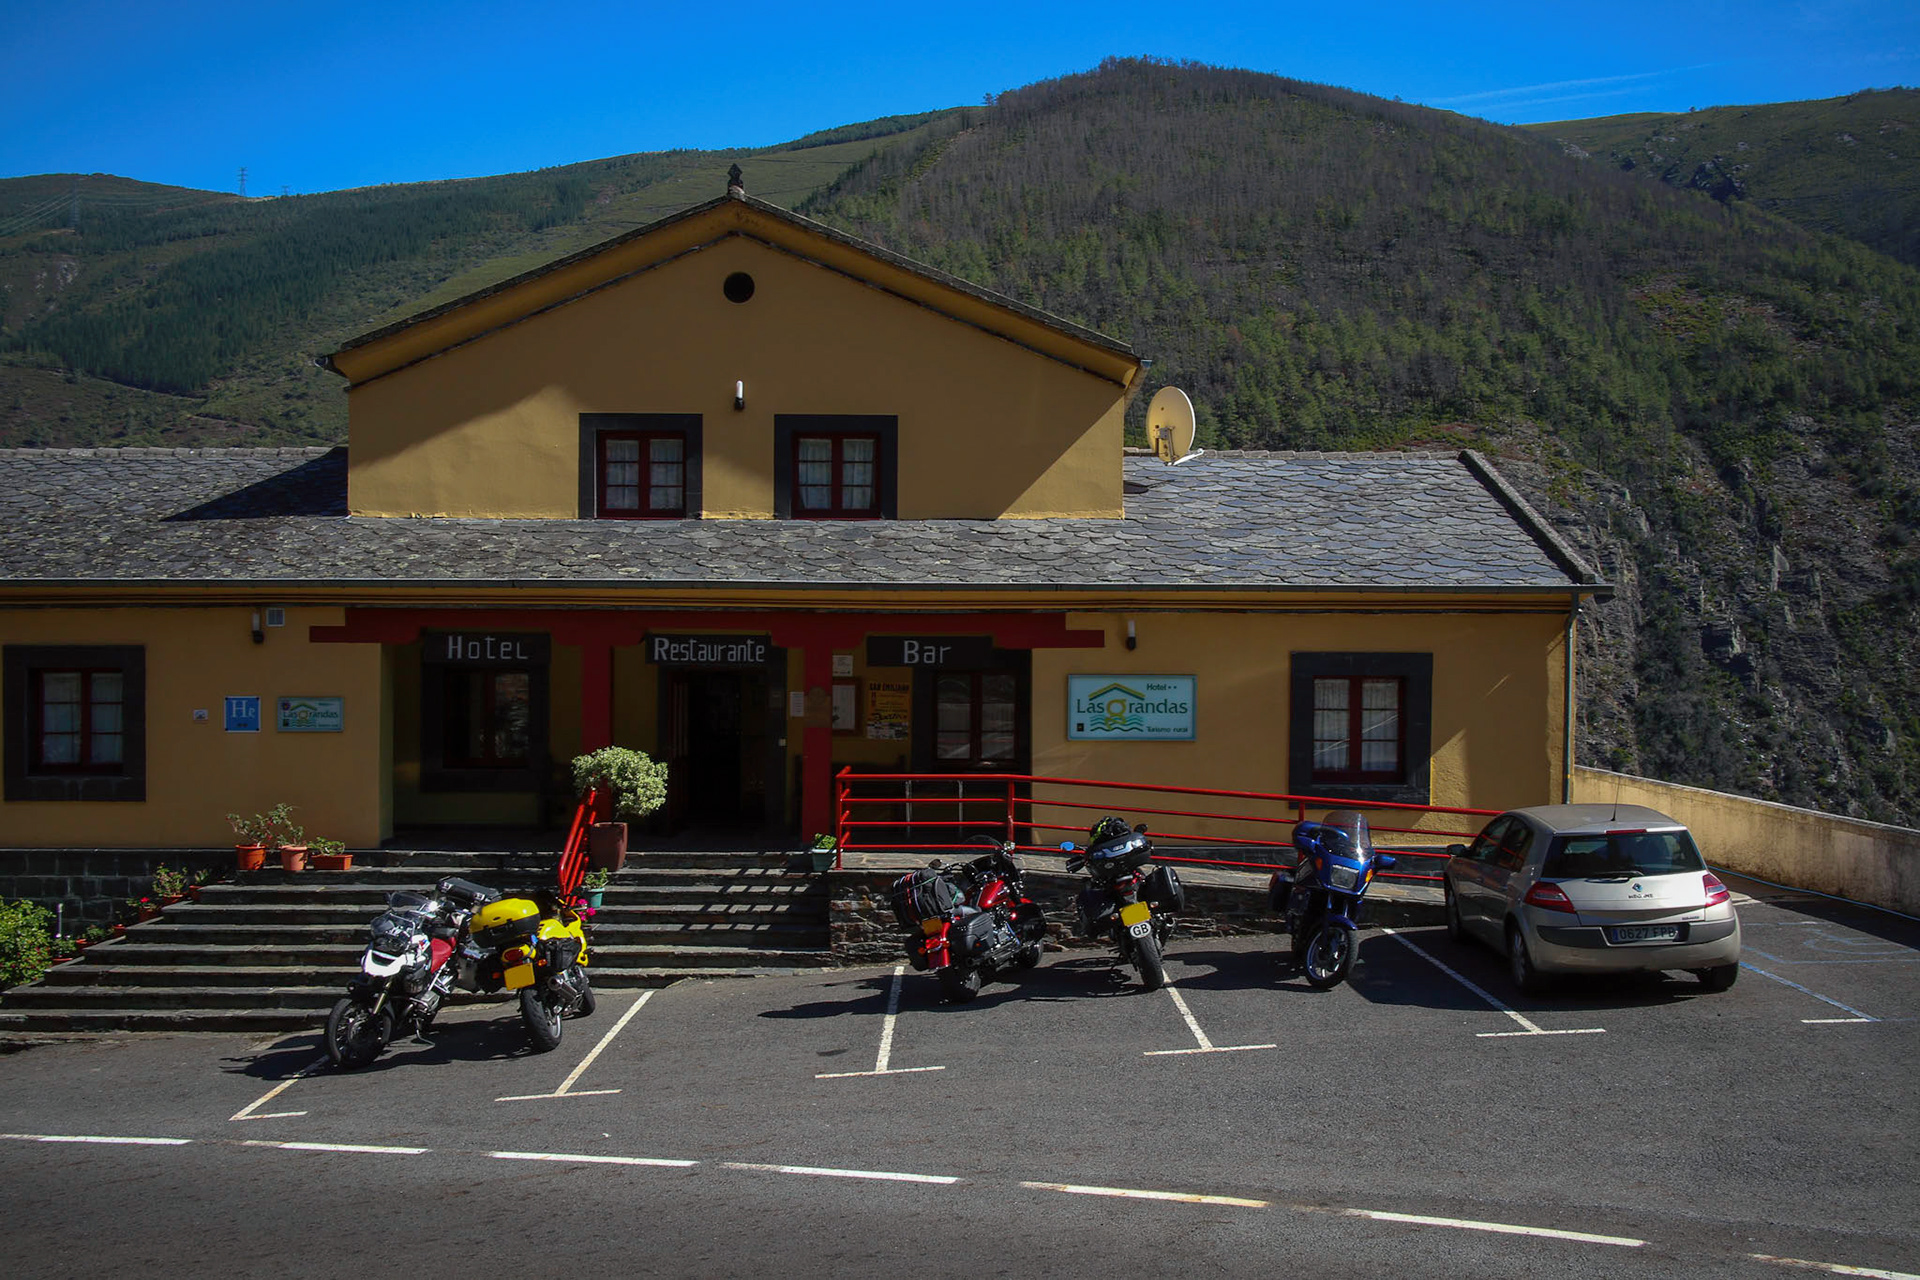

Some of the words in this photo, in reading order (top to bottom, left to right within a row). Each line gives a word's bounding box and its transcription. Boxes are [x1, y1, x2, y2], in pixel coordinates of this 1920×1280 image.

[653, 637, 765, 663] Restaurante
[903, 640, 953, 664] Bar
[1146, 683, 1167, 691] Hotel
[1133, 924, 1149, 936] GB
[1619, 927, 1649, 940] 0627
